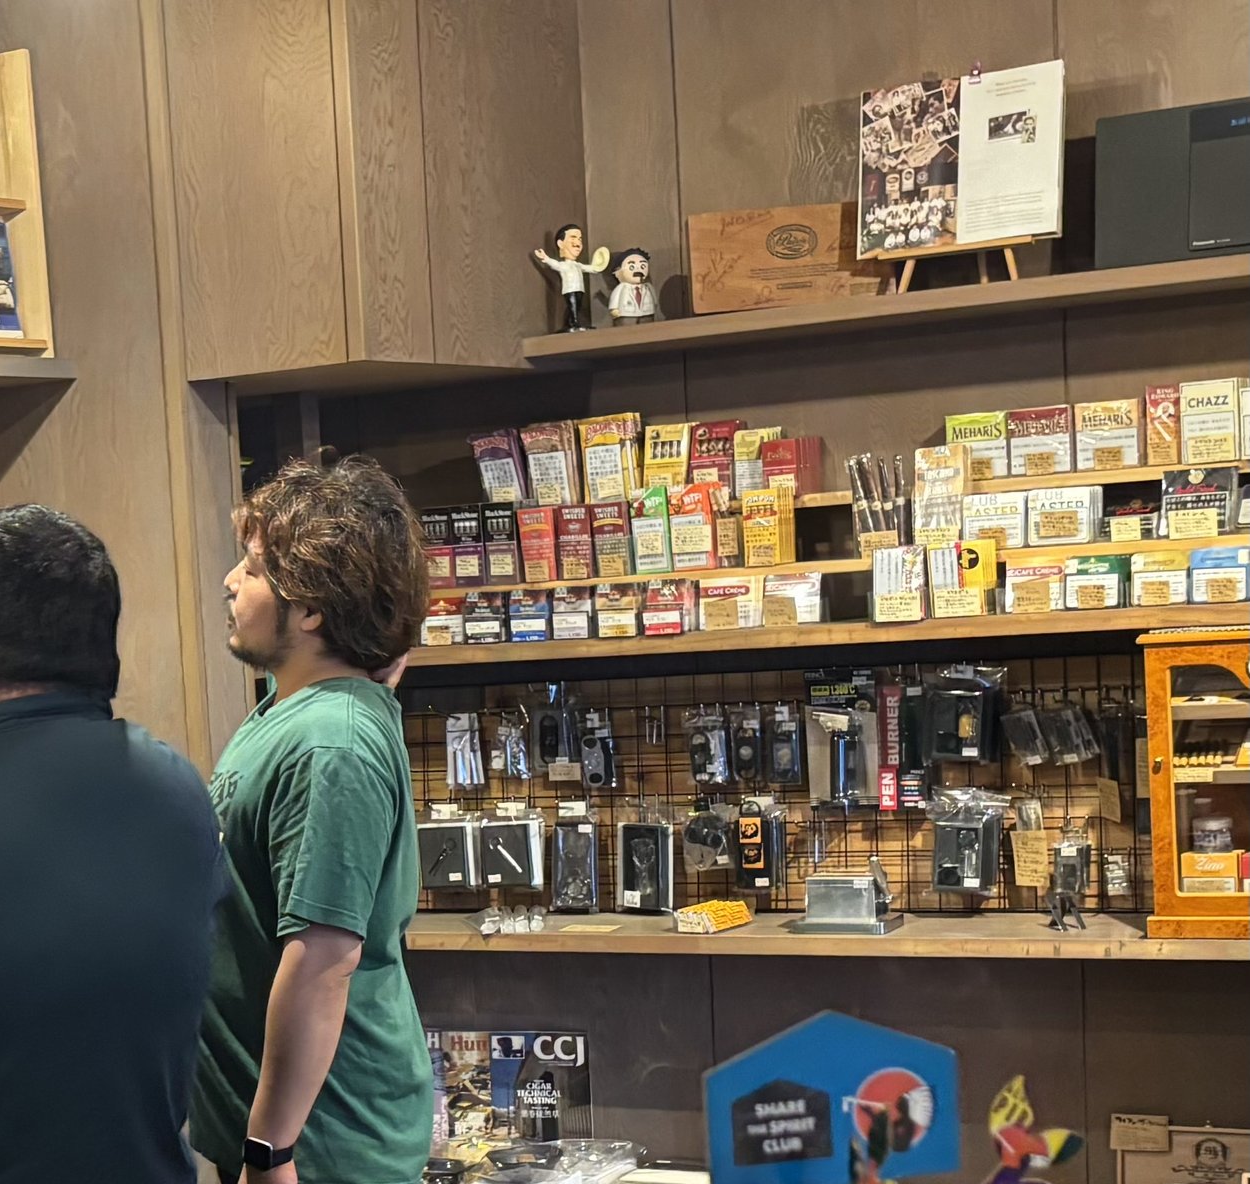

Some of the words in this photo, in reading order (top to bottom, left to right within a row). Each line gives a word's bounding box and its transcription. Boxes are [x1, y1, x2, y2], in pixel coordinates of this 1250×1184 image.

[1187, 395, 1229, 409] CHAZZ
[886, 695, 900, 765] BURNER
[881, 772, 895, 807] PEN
[1195, 855, 1226, 872] Zino
[533, 1035, 586, 1067] CCJ
[525, 1082, 553, 1090] CIGAR
[523, 1096, 558, 1105] TASTING
[754, 1099, 807, 1118] SHARE
[762, 1136, 804, 1154] CLUB
